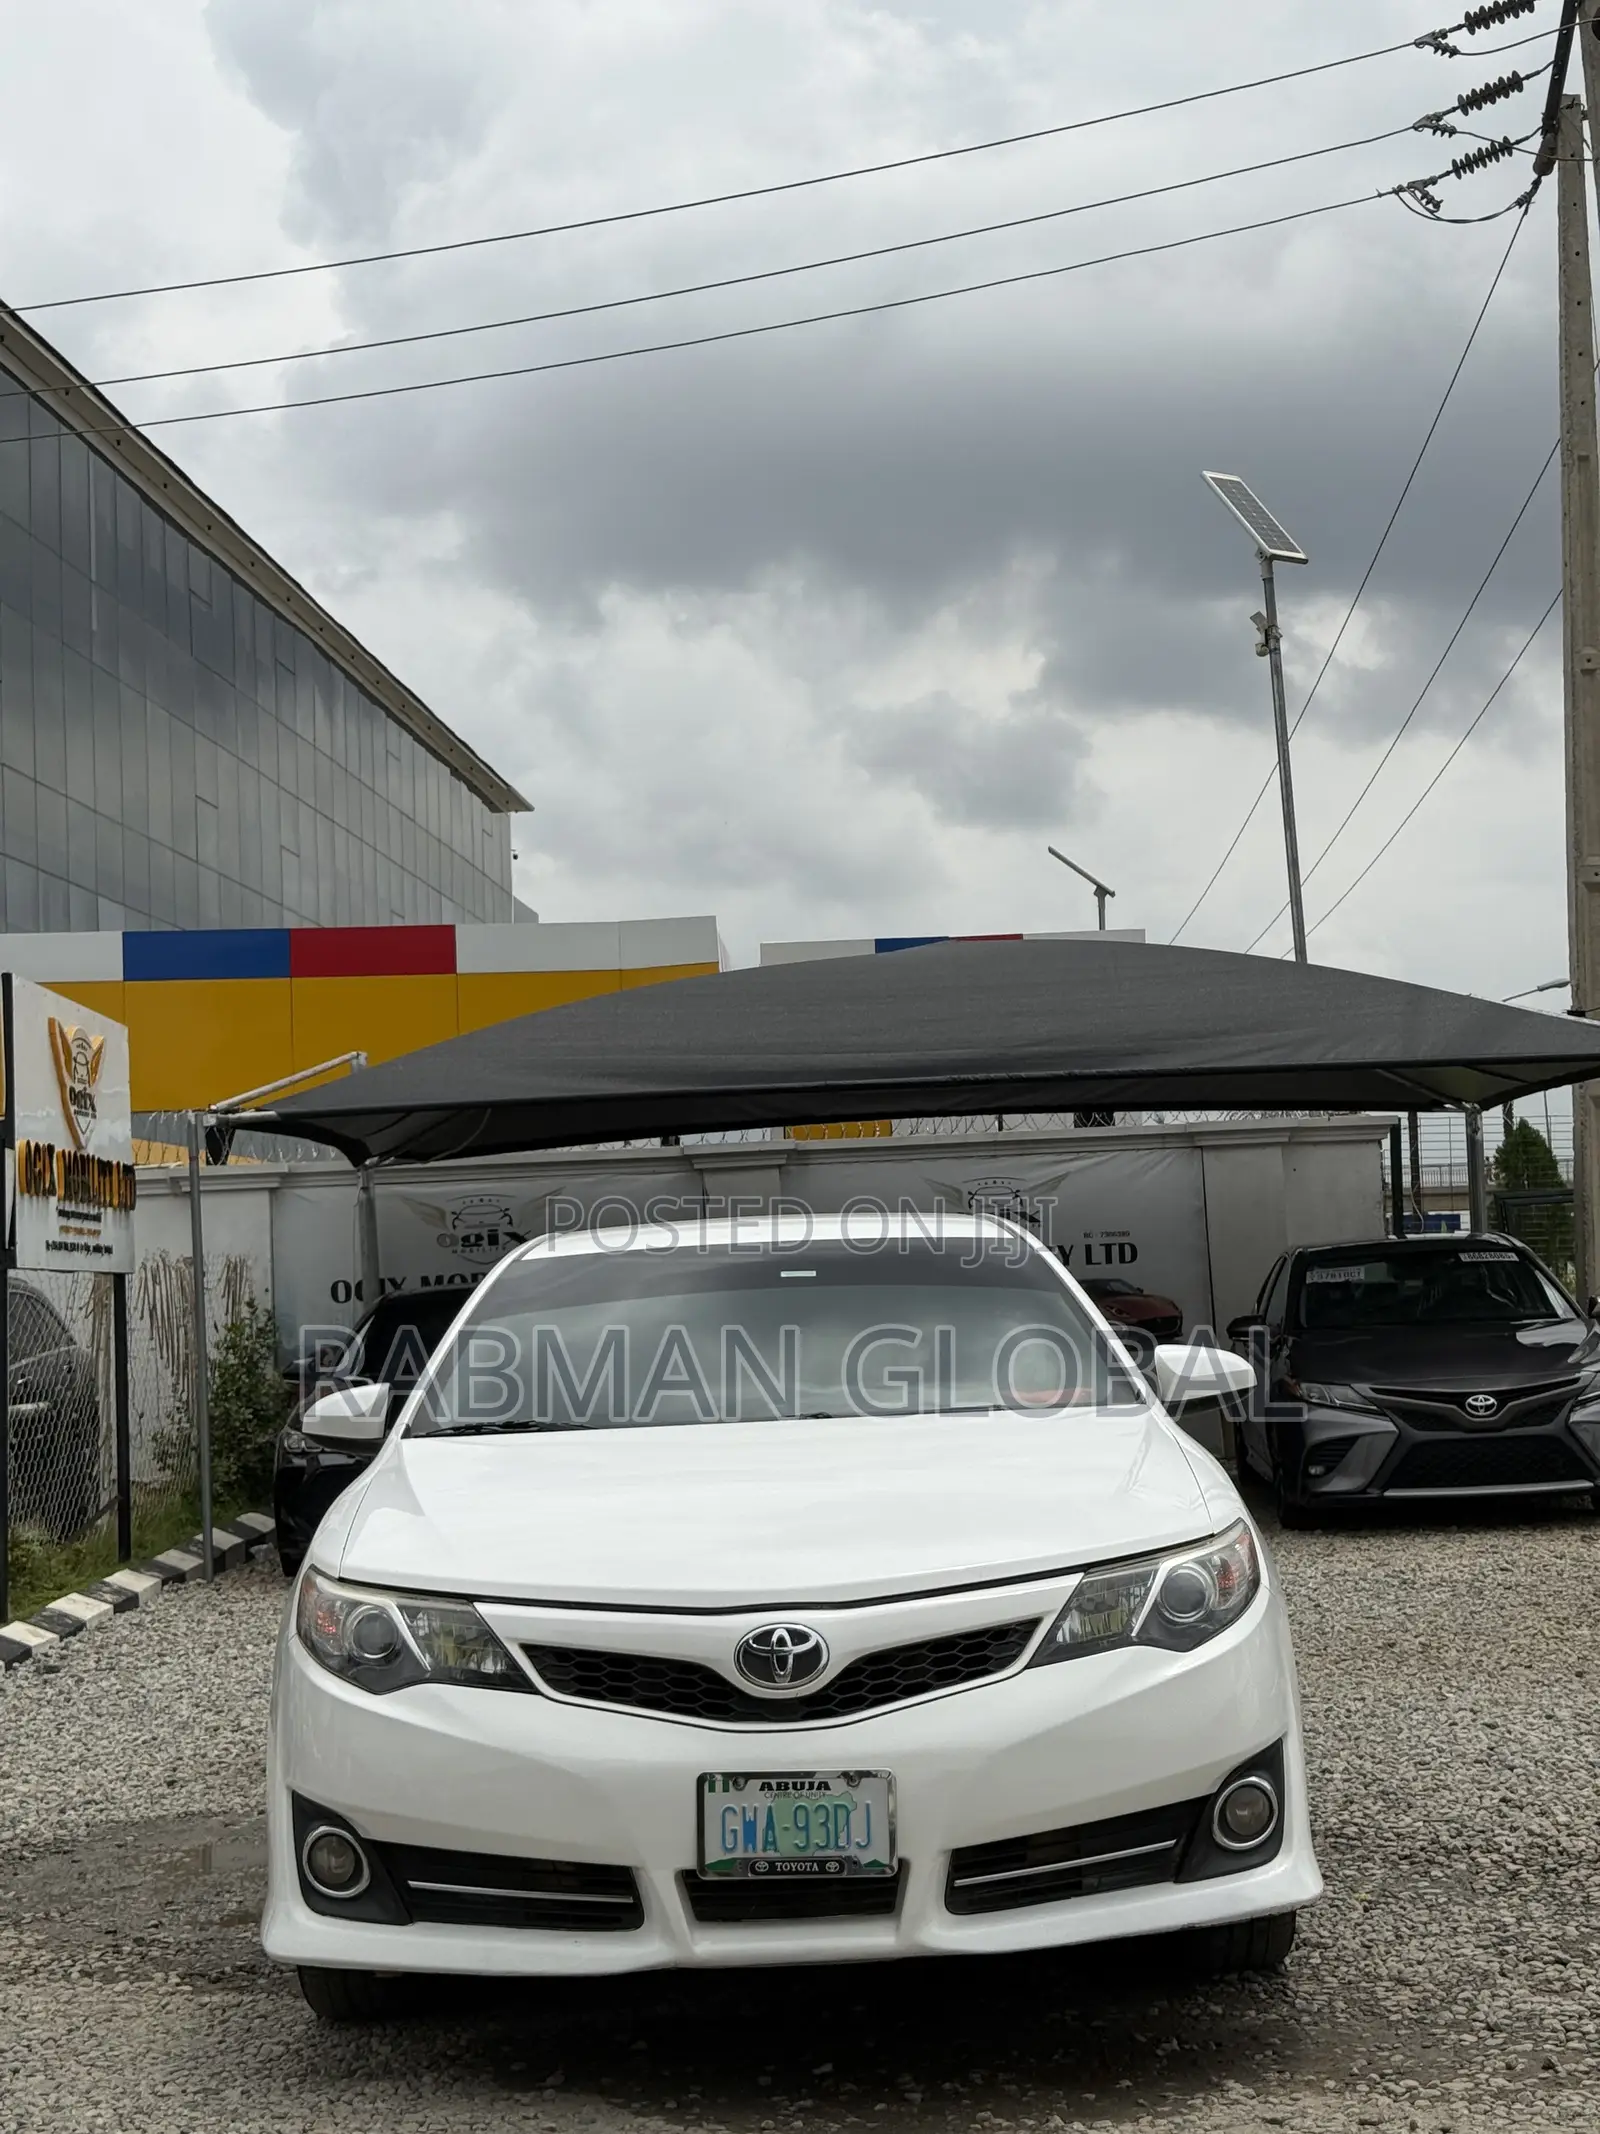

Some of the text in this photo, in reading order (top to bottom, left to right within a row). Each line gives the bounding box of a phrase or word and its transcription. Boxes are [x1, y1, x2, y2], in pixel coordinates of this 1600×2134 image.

[1084, 1242, 1138, 1266] LTD
[759, 1781, 832, 1792] ABUJA
[720, 1800, 873, 1855] GWA-93DJ
[775, 1861, 820, 1872] TOYOTA
